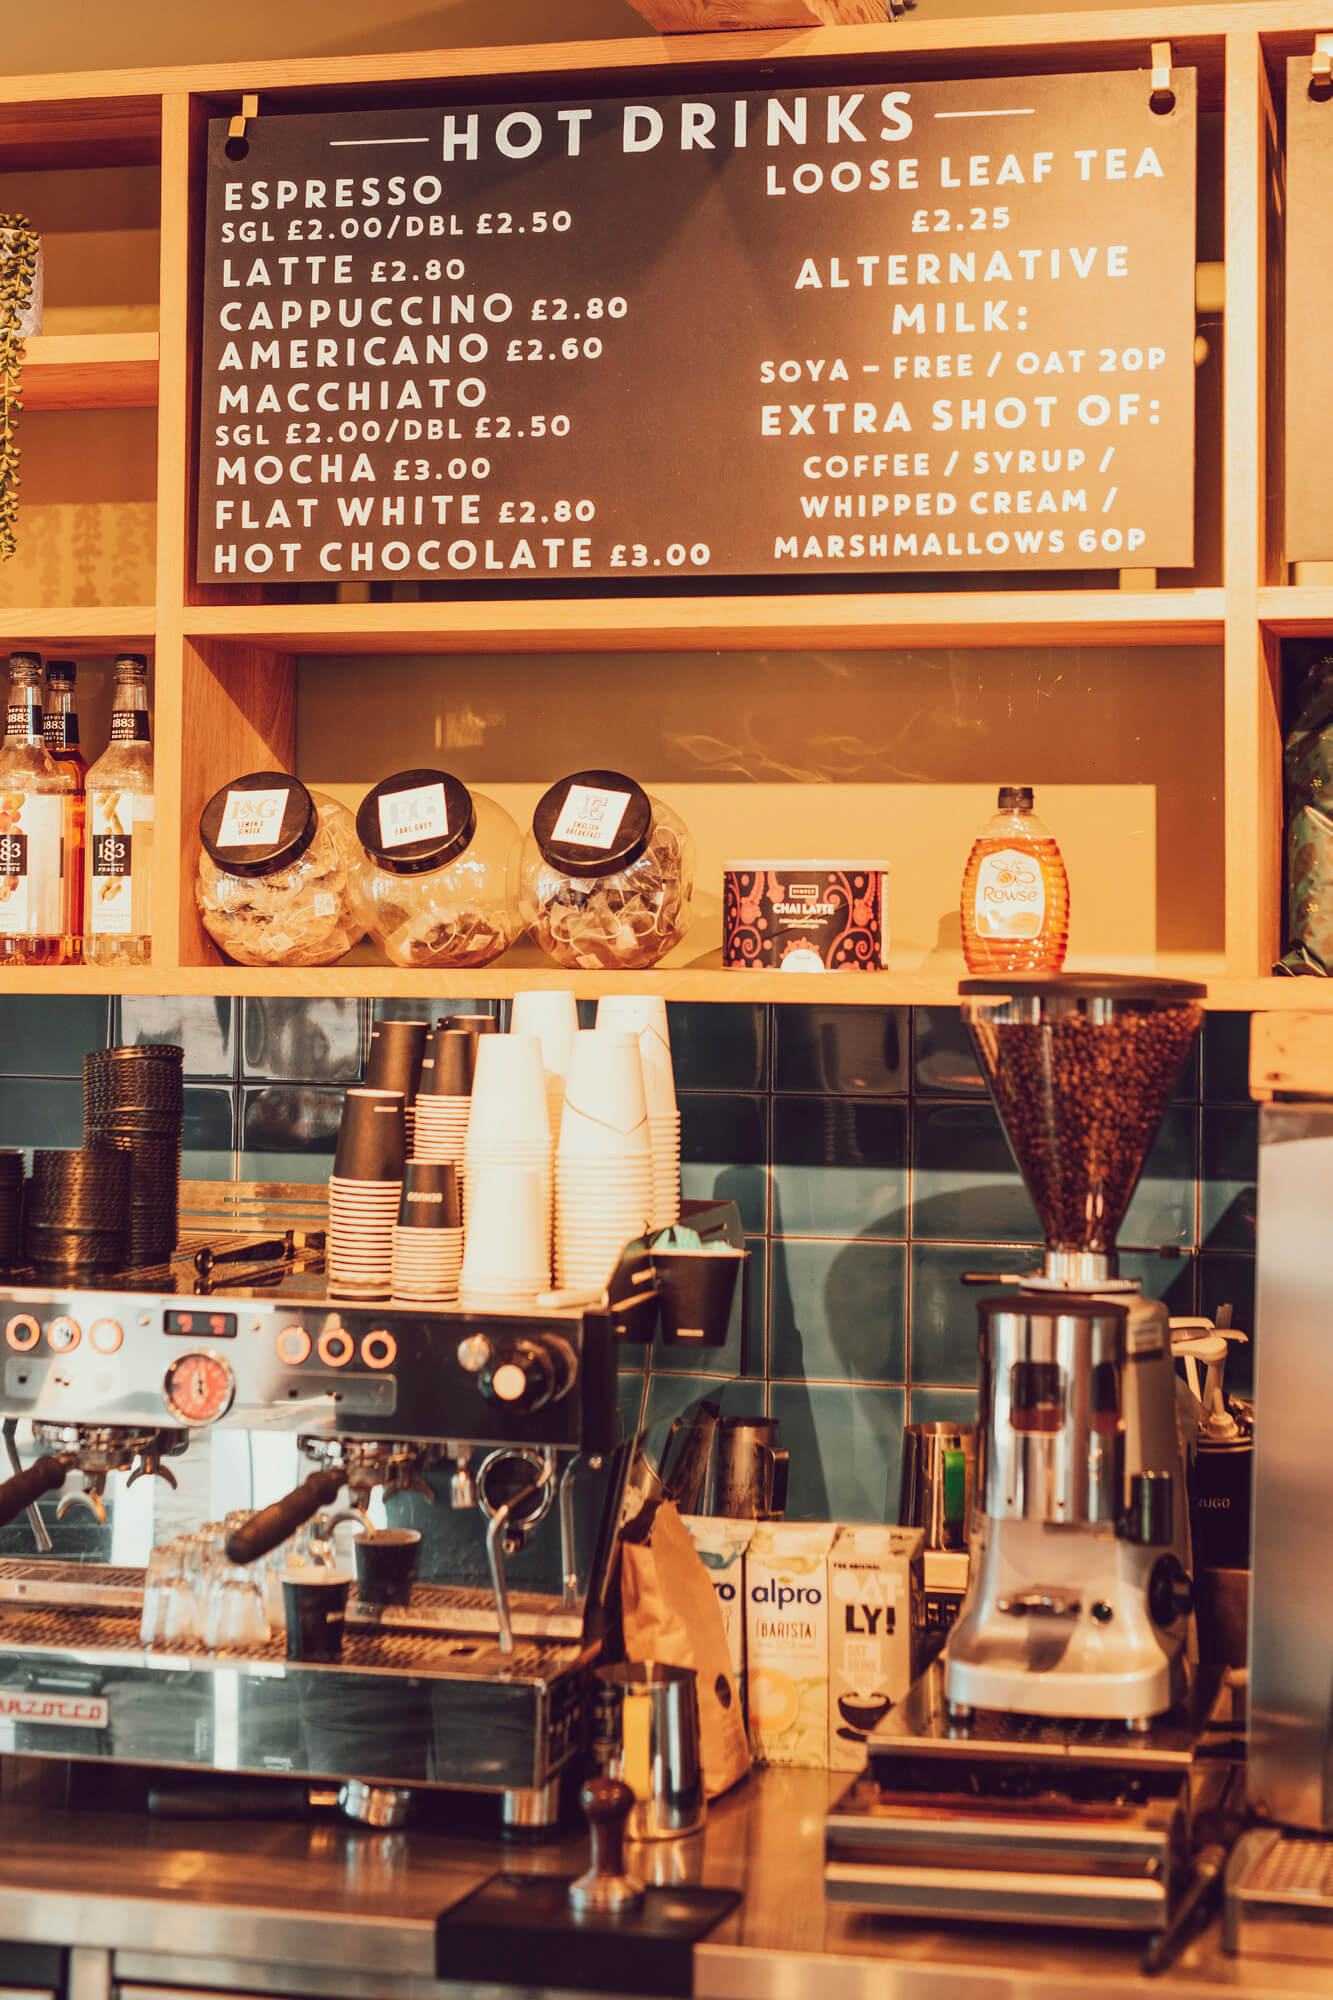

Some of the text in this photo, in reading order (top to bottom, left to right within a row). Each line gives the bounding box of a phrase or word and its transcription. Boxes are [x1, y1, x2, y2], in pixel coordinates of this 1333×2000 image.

[443, 91, 912, 162] HOT DRINKS
[766, 146, 1164, 196] LOOSE LEAF TEA
[225, 175, 441, 211] ESPRESSO
[221, 210, 571, 243] SGL £2.00/DBL £2.50
[911, 206, 1010, 233] £2.25
[223, 255, 464, 288] LATTE £2.80
[794, 245, 1128, 289] ALTERNATIVE
[220, 293, 626, 332] CAPPUCCINO £2.80
[892, 300, 1027, 335] MILK:
[218, 333, 602, 371] AMERICANO £2.60
[760, 358, 848, 384] SOYA
[893, 353, 972, 380] FREE
[986, 351, 1002, 378] /
[1015, 349, 1085, 375] OAT
[1098, 347, 1165, 372] 20P
[218, 377, 485, 414] MACCHIATO
[215, 415, 569, 447] SGL £2.00/DBL £2.50
[761, 393, 1159, 436] EXTRA SHOT OF:
[216, 453, 489, 486] MOCHA £3.00
[803, 445, 1115, 479] COFFEE / SYRUP /
[216, 494, 594, 530] FLAT WHITE £2.80
[800, 486, 1117, 518] WHIPPED CREAM /
[214, 537, 709, 573] HOT CHOCOLATE £3.00
[774, 527, 1145, 559] MARSHMALLOWS 60P
[8, 713, 30, 723] 1883
[43, 721, 64, 730] 1883
[112, 719, 135, 728] 1883
[0, 838, 22, 861] 883
[97, 838, 126, 862] 1883
[772, 903, 835, 915] CHAI LATTE
[983, 886, 1038, 904] Rowse
[751, 1577, 822, 1610] alpro
[845, 1604, 896, 1635] LY!
